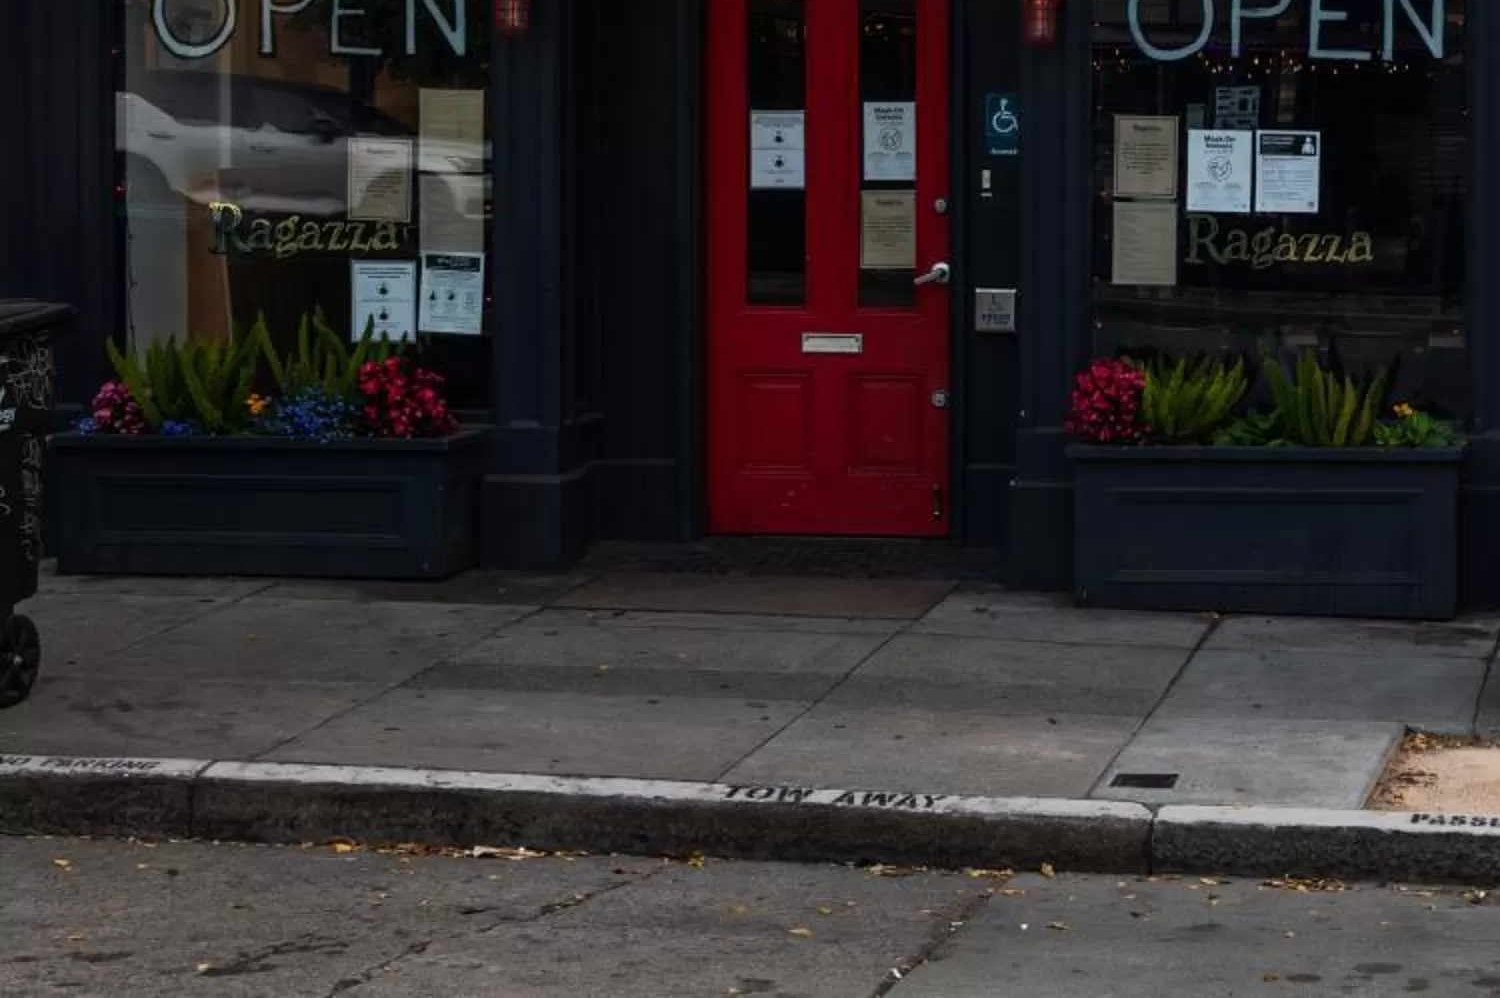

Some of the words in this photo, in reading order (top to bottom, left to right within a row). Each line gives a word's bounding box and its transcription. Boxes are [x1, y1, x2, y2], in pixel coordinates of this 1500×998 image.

[208, 201, 400, 258] Ragazza
[1184, 213, 1374, 270] Ragazza
[722, 785, 814, 803] TOW
[832, 791, 947, 808] AWAY
